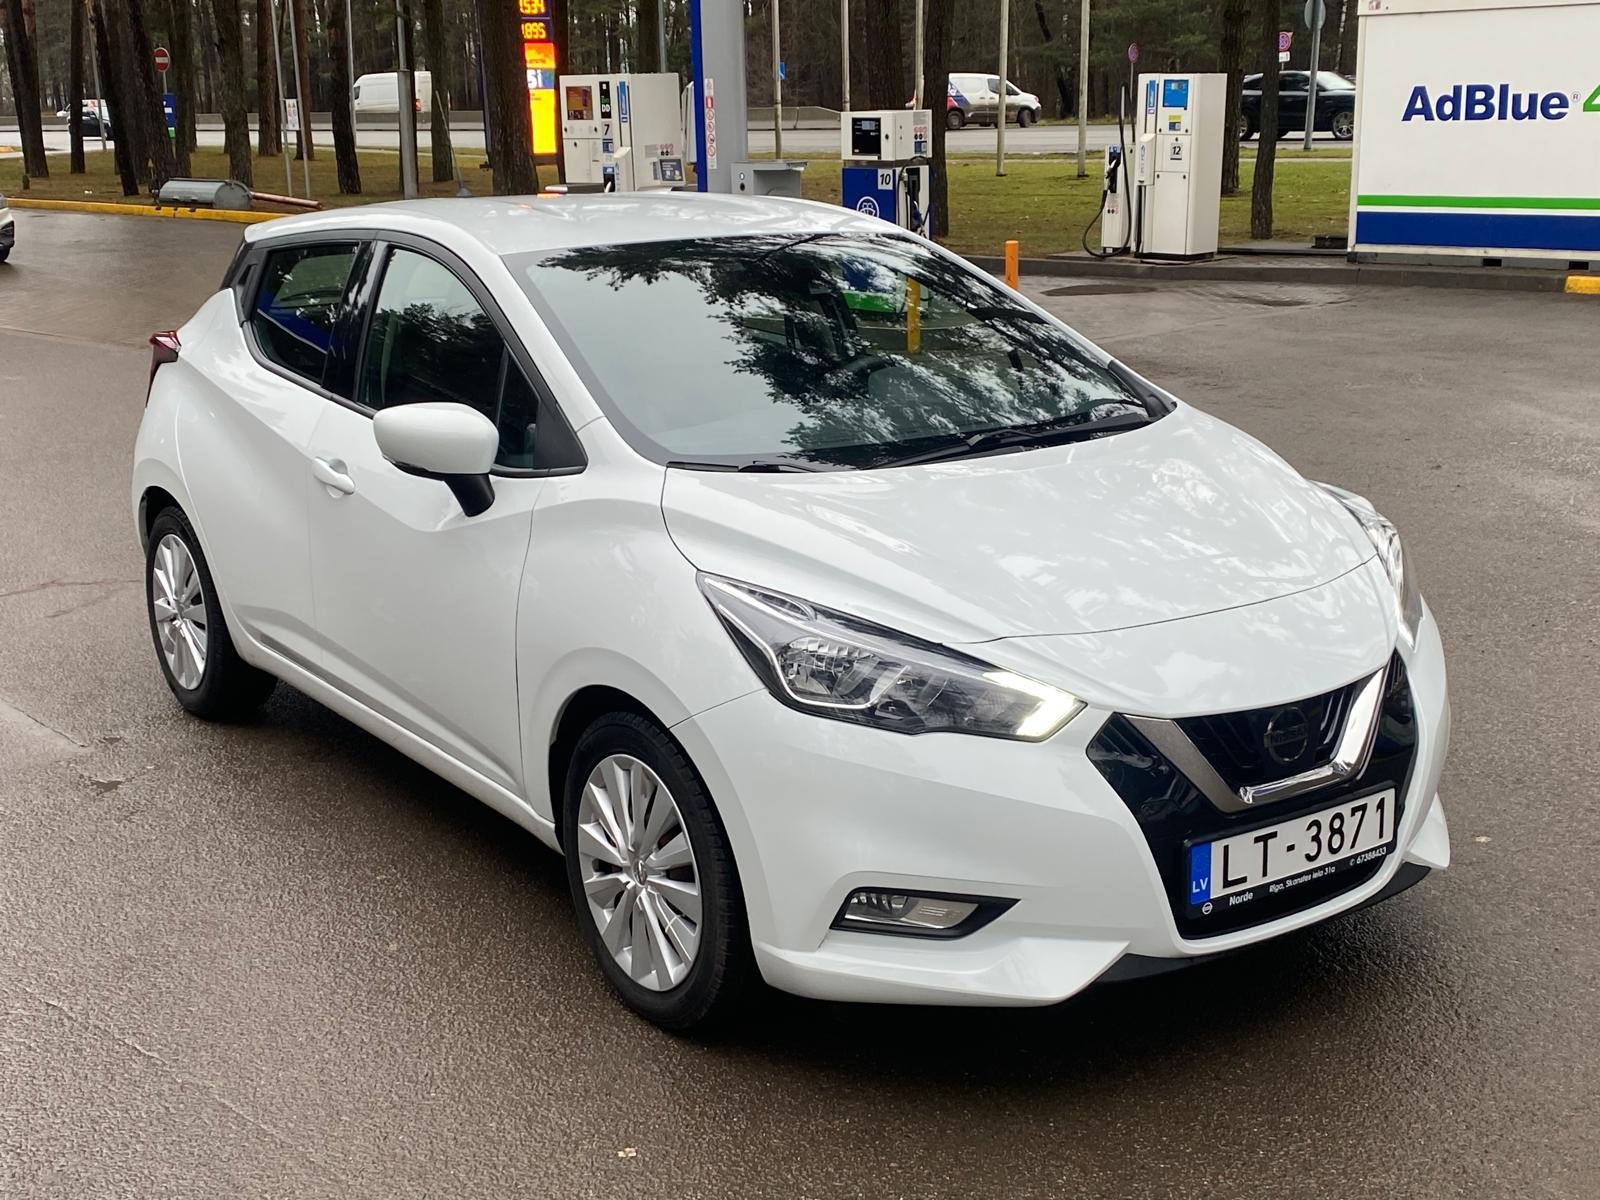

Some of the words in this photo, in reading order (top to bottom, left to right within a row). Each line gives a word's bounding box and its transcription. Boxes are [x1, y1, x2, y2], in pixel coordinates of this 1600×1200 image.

[604, 124, 610, 136] 7
[1172, 145, 1181, 155] 12
[879, 173, 891, 185] 10
[1222, 797, 1386, 890] LT-3871
[1192, 877, 1209, 893] LV
[1229, 891, 1254, 907] Norde
